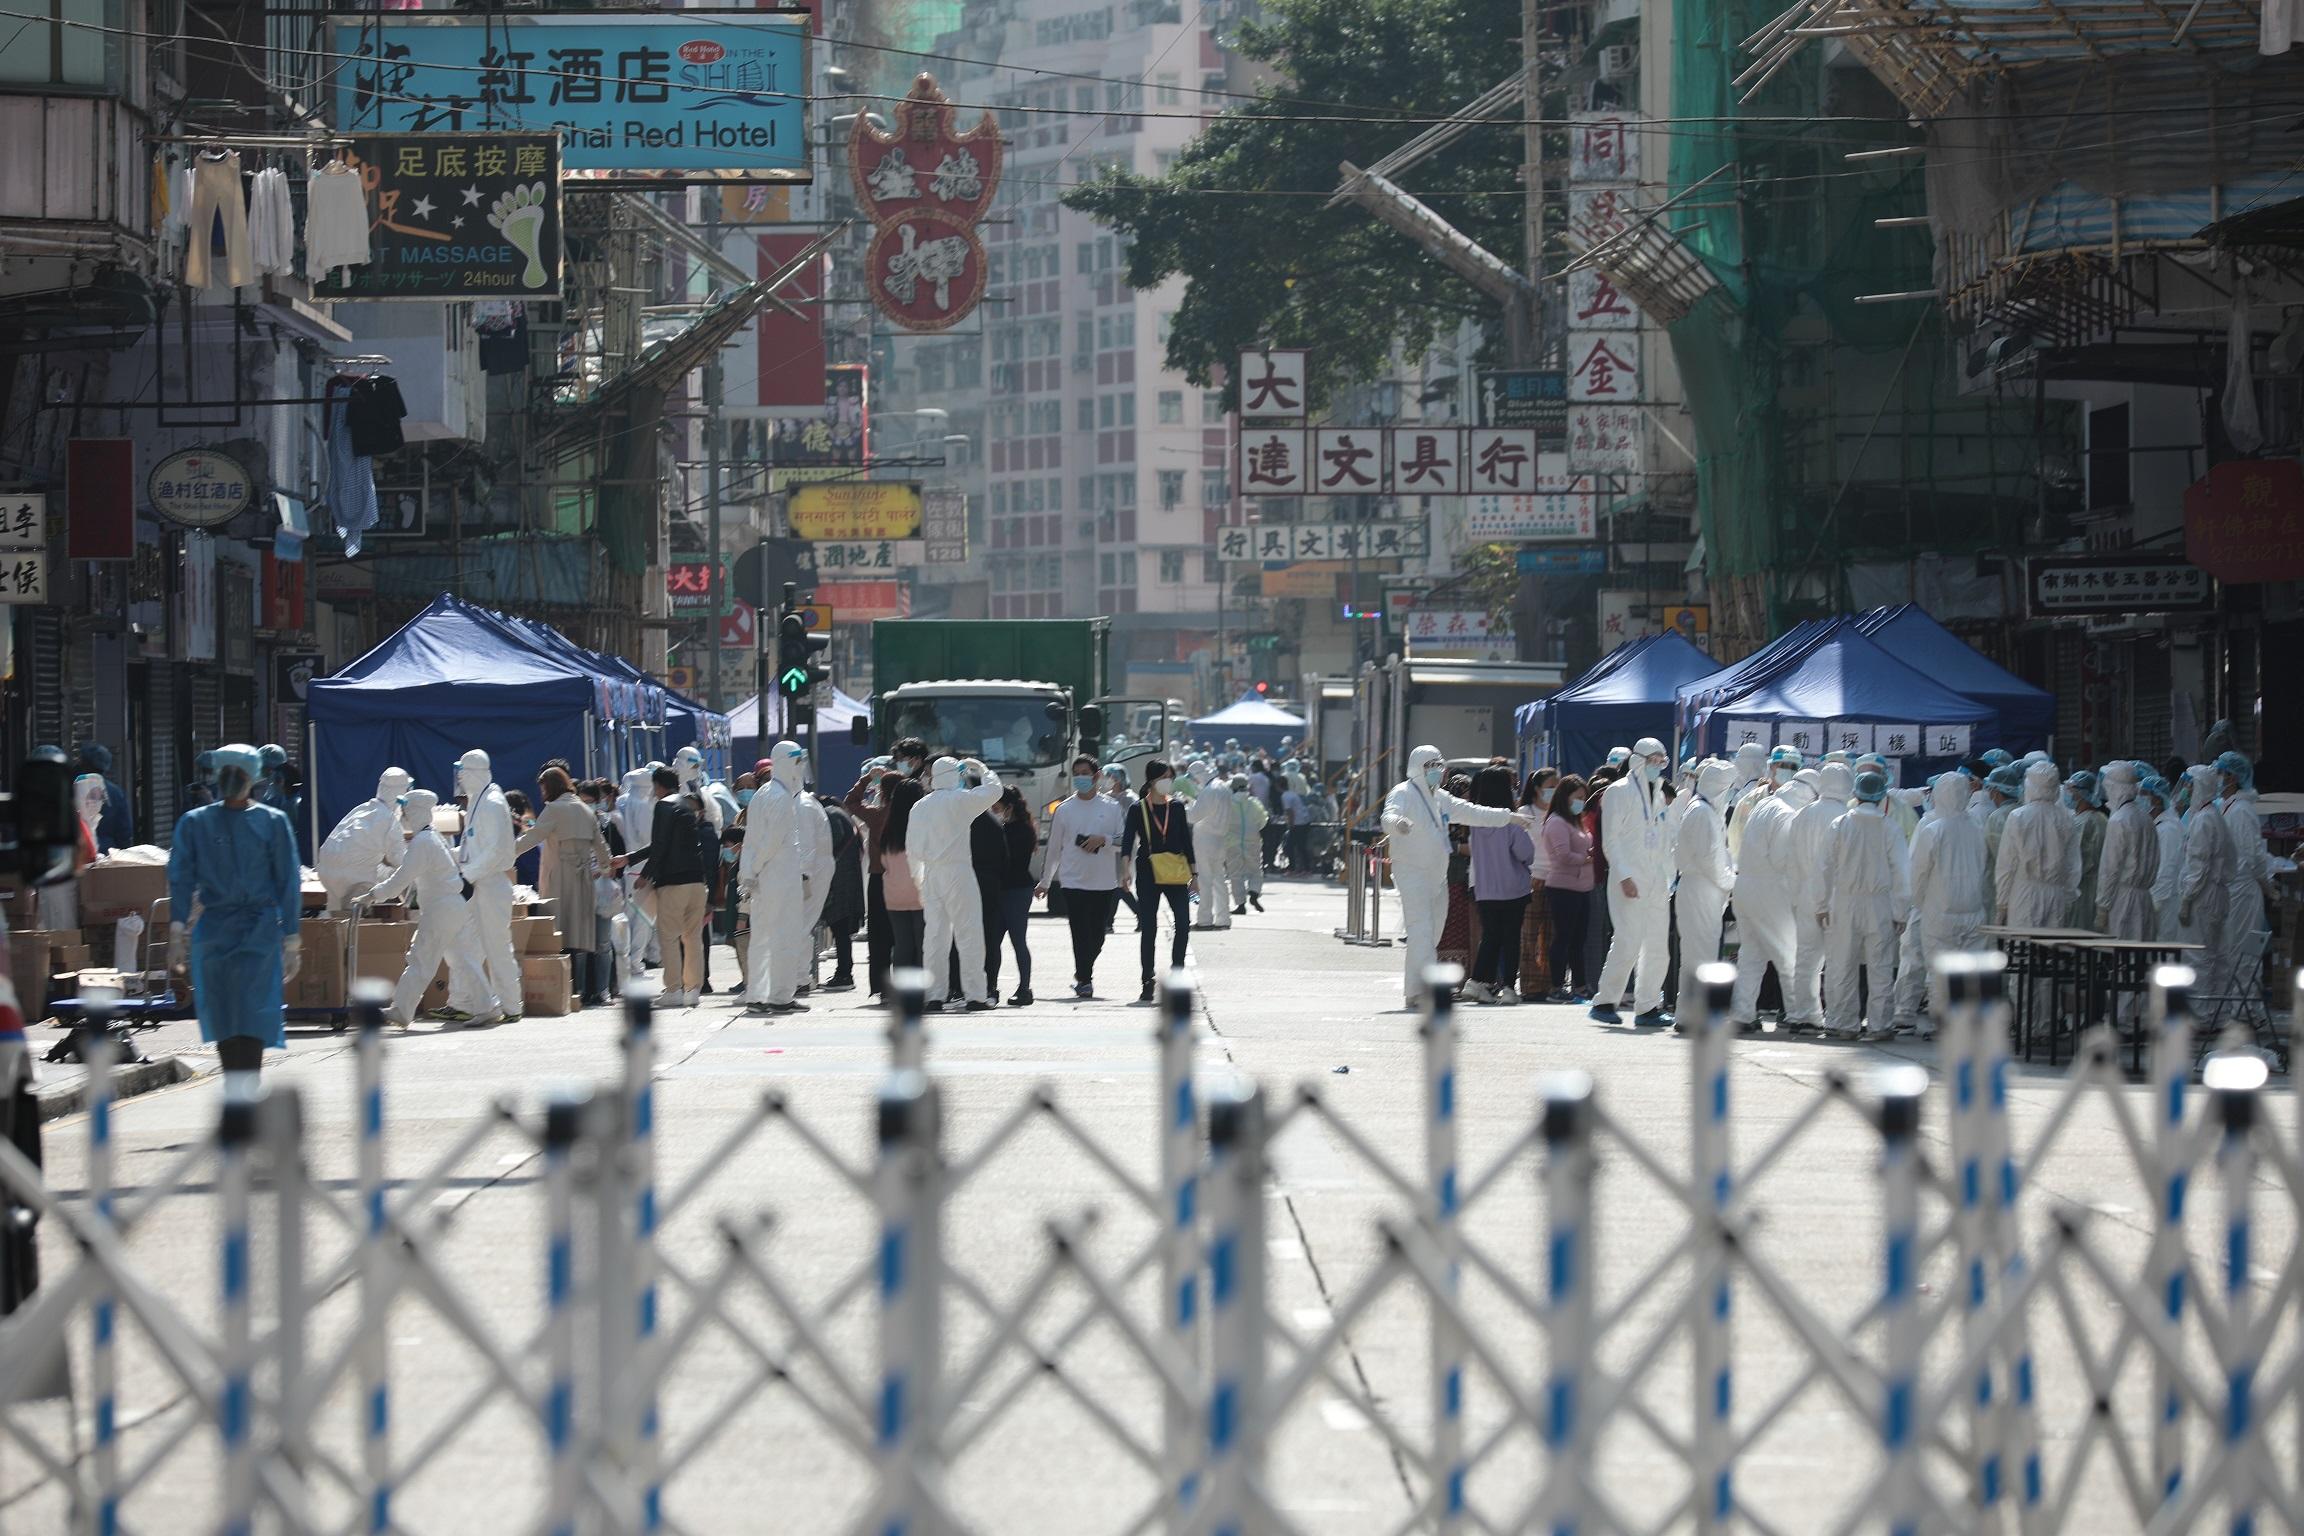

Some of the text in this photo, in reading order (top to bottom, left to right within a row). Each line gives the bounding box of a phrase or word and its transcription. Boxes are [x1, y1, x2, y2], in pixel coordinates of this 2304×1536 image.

[625, 120, 682, 148] Red
[695, 119, 775, 147] Hotel
[394, 144, 548, 178] 足底按摩
[401, 245, 513, 264] MASSAGE
[463, 270, 517, 287] 24hour
[928, 548, 962, 560] 128
